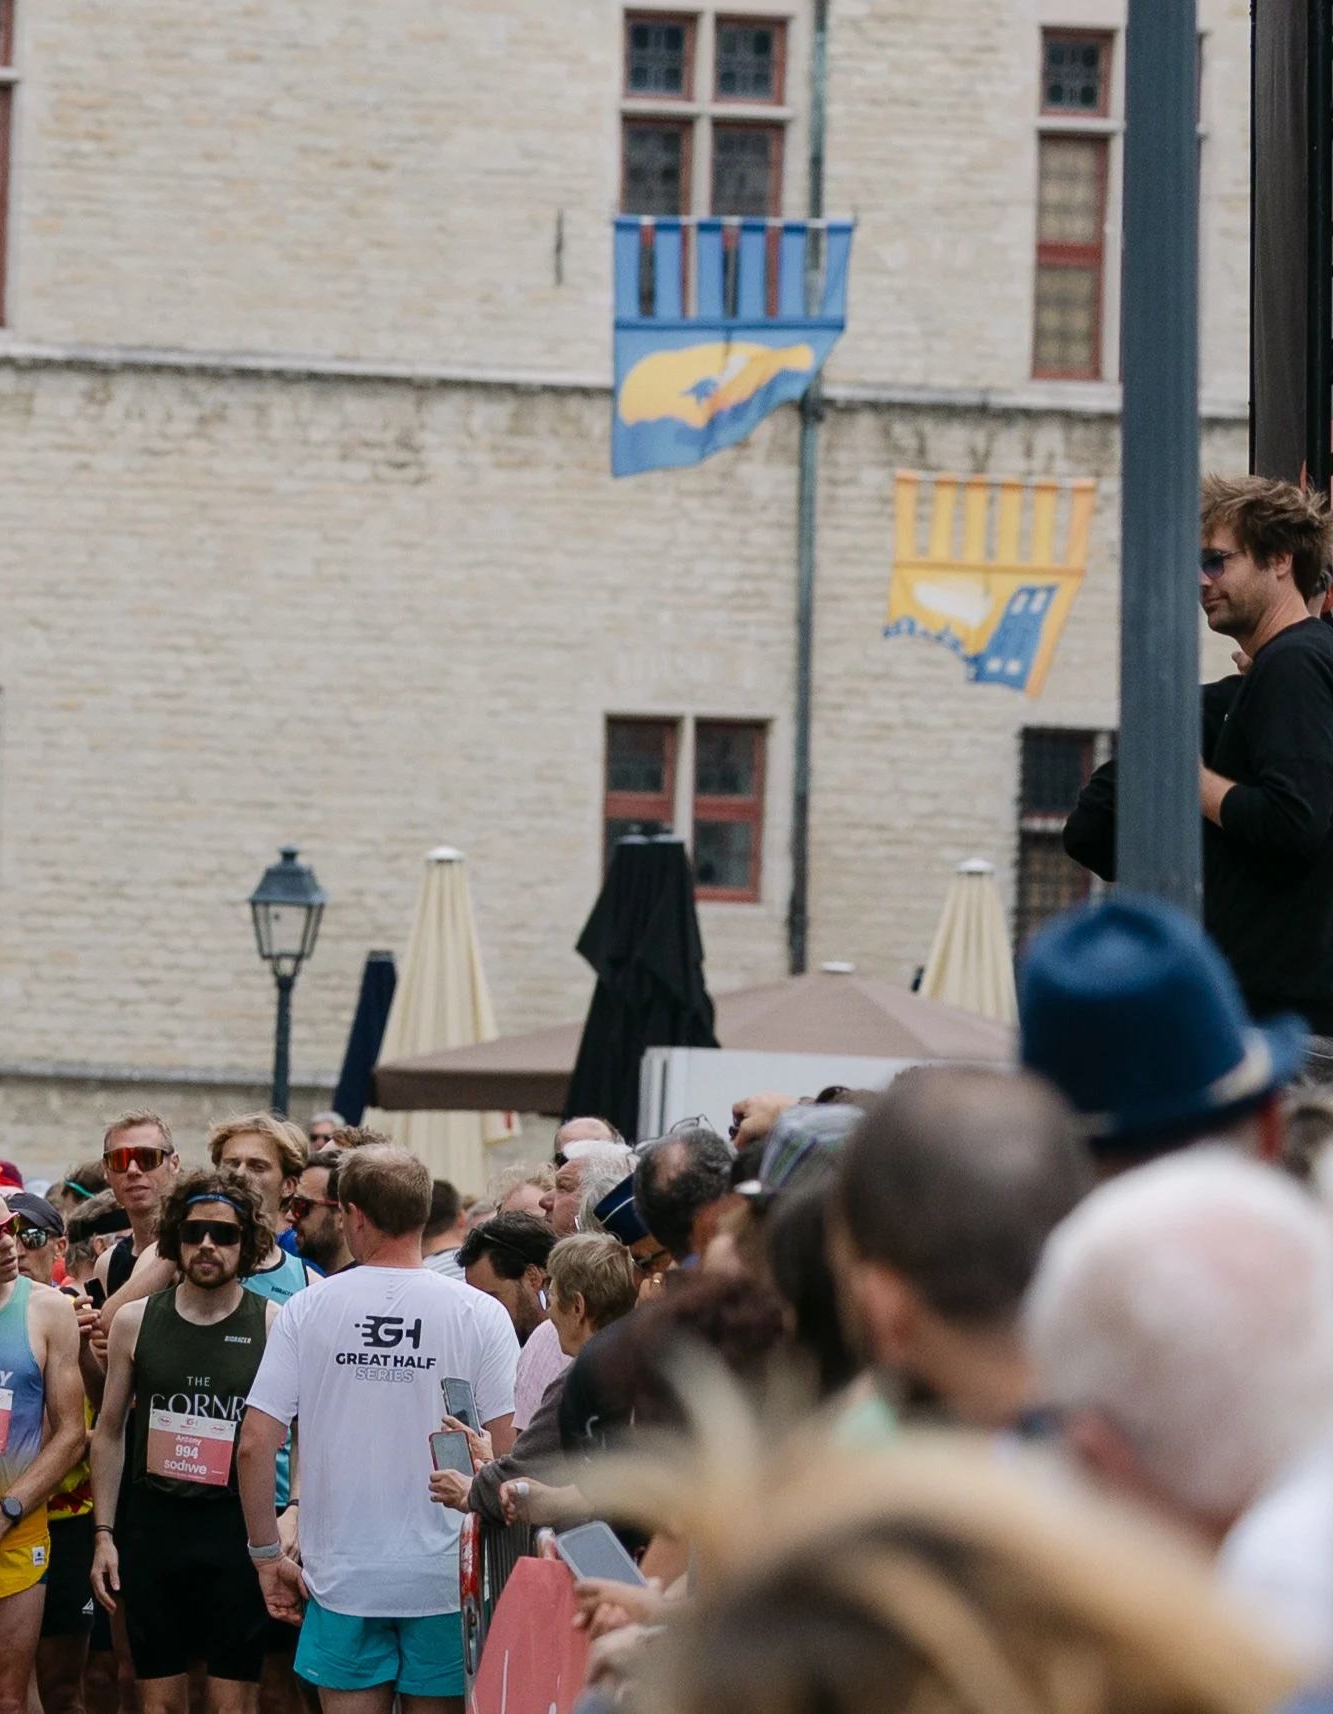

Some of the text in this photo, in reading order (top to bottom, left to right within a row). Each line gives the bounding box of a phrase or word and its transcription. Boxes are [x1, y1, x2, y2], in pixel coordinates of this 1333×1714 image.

[335, 1352, 437, 1370] GREAT HALF
[186, 1376, 211, 1387] THE
[355, 1366, 415, 1383] SERIES
[175, 1444, 200, 1459] 994
[163, 1459, 208, 1475] sodiwe
